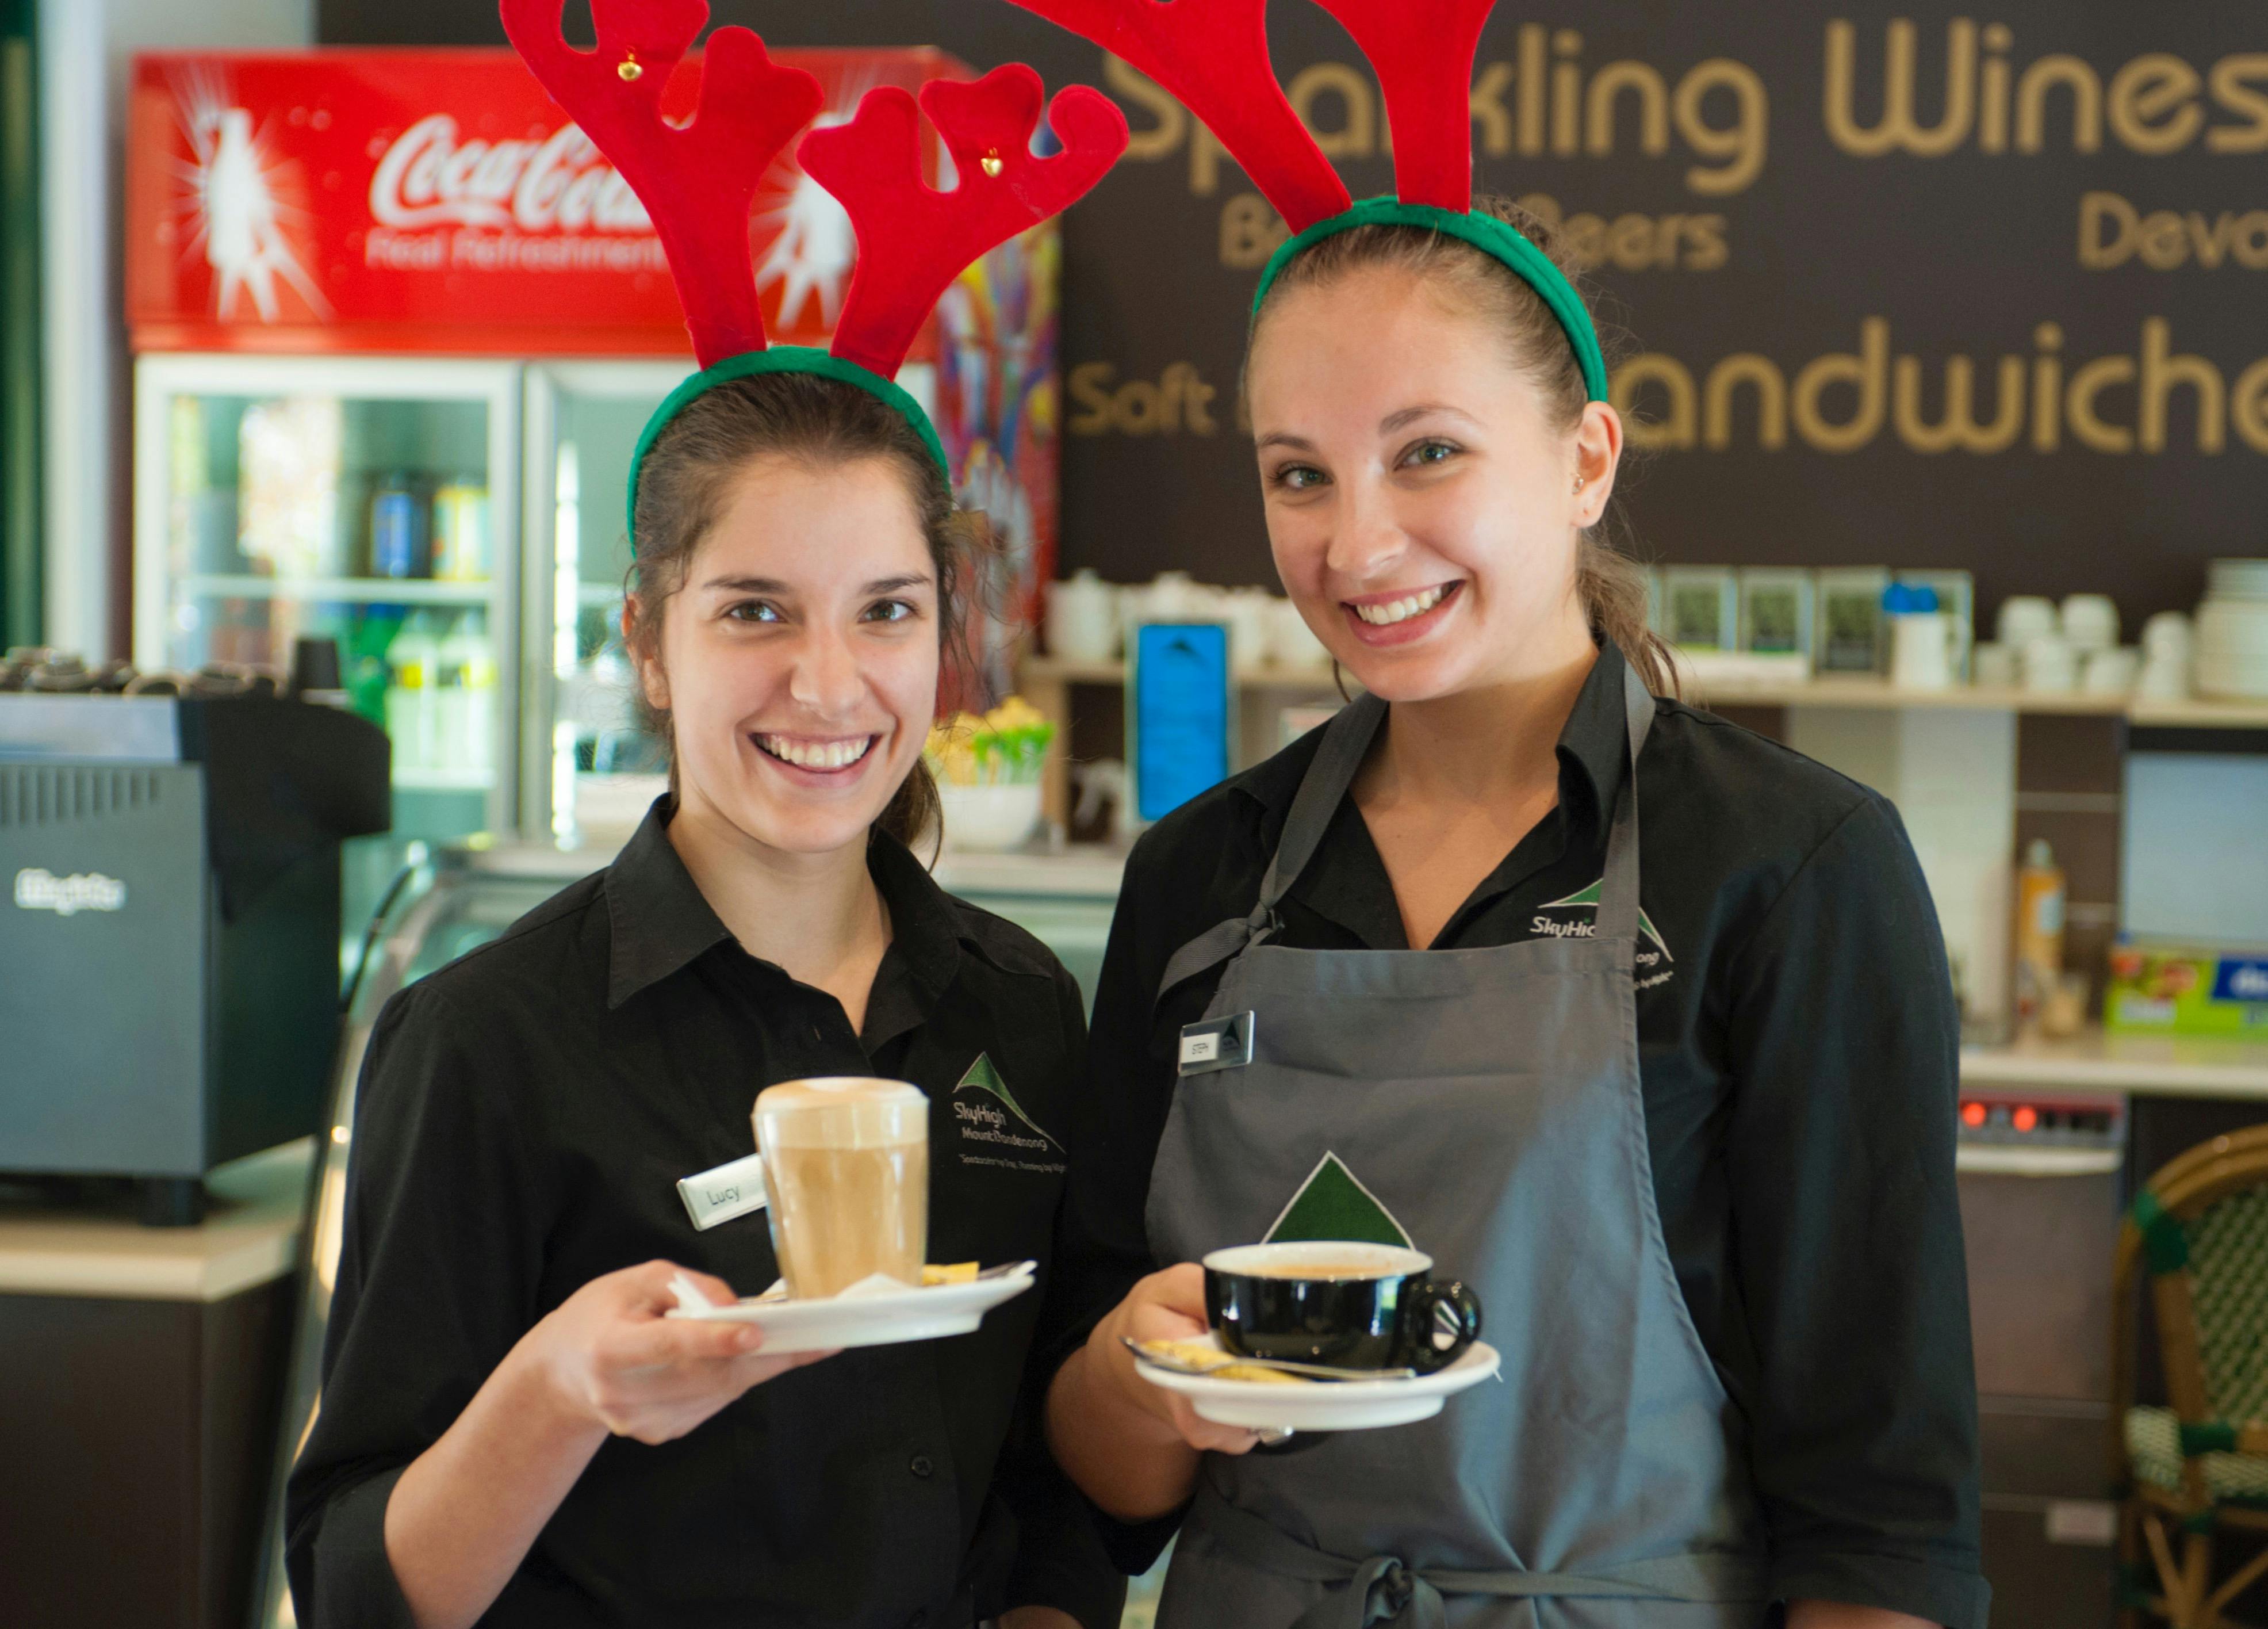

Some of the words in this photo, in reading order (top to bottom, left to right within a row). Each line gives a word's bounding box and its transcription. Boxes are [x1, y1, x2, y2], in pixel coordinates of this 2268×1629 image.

[1103, 21, 1769, 196] Sakling
[1824, 16, 2268, 158] Wines
[369, 112, 657, 229] Coca-Co
[1068, 360, 1217, 435] Soft
[1608, 315, 2268, 454] andwich
[1529, 916, 1596, 938] SkyHi
[953, 1101, 1007, 1129] SkyHigh
[707, 1186, 740, 1206] Lucy
